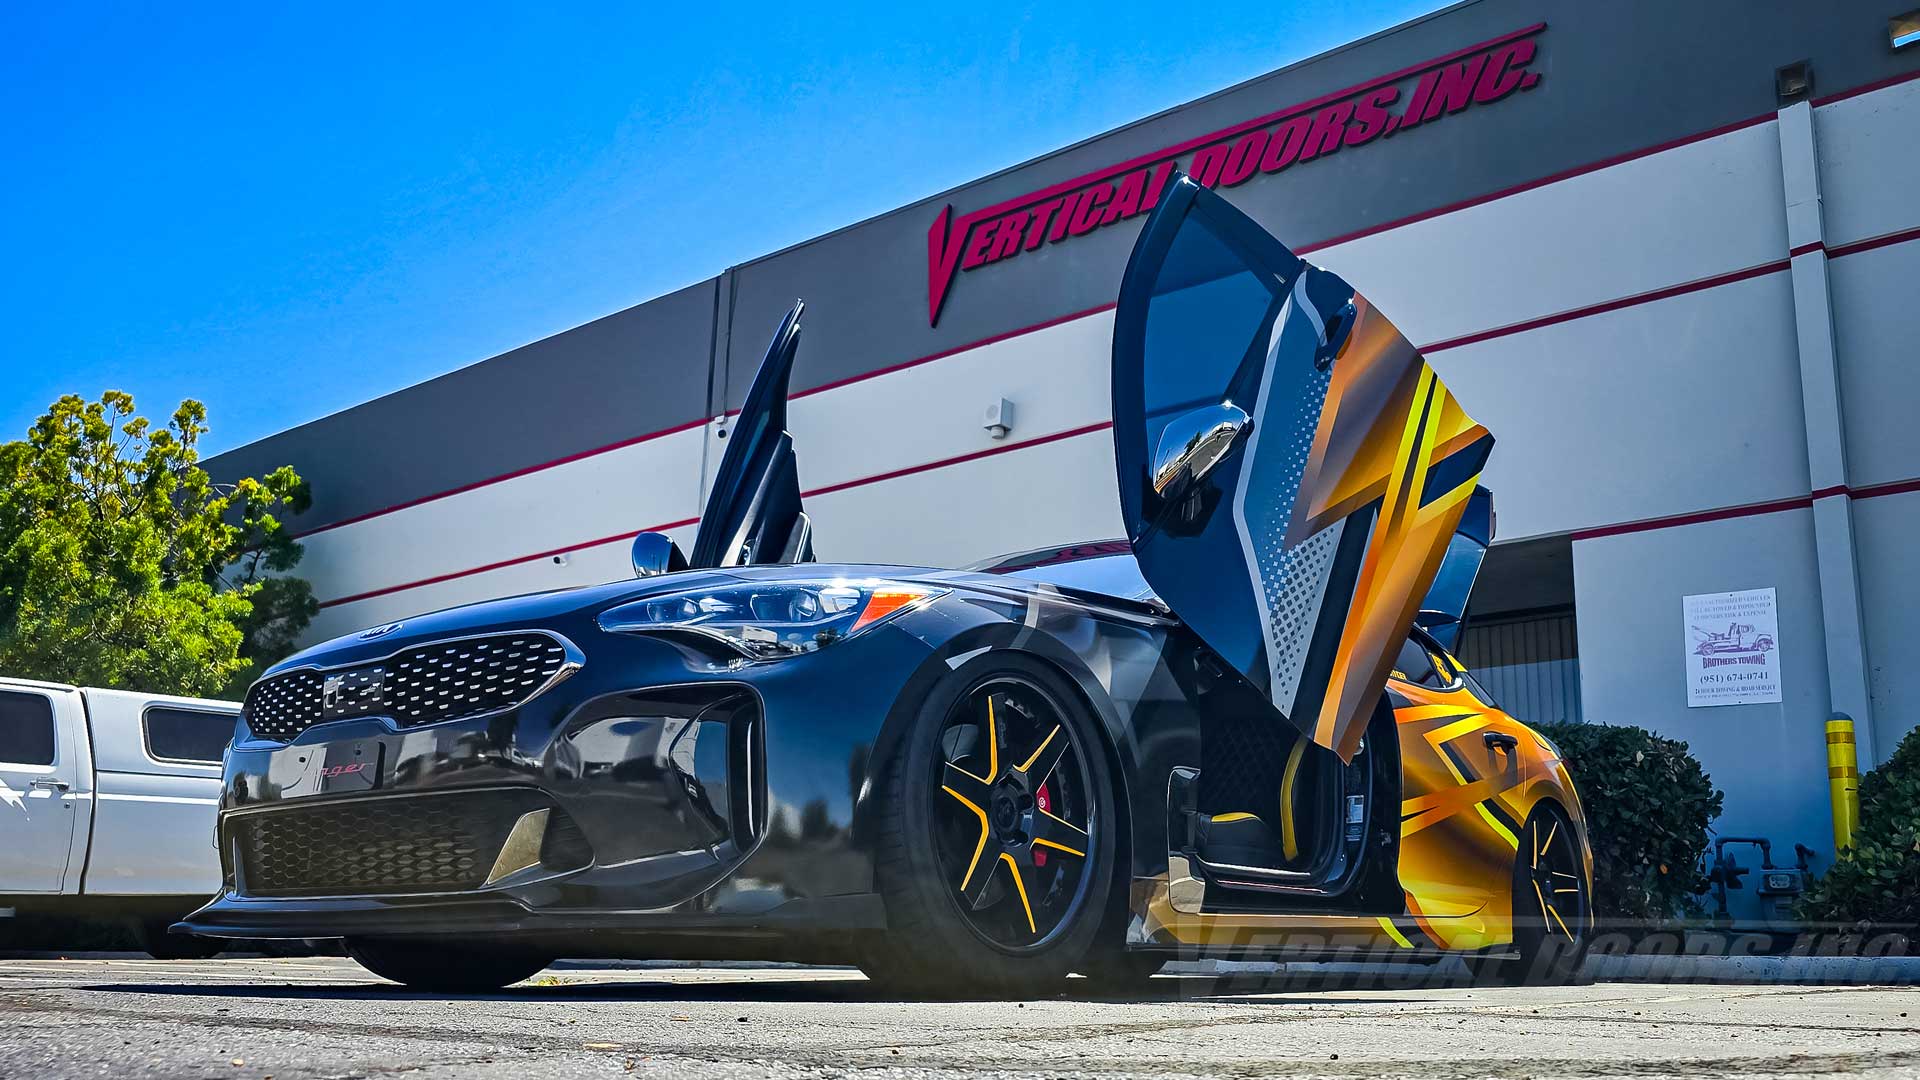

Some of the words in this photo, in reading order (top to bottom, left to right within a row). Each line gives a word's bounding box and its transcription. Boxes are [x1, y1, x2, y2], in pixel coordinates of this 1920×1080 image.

[1703, 657, 1737, 669] BROTHERS
[1738, 653, 1766, 665] TOWING
[1700, 674, 1724, 684] (951)
[1727, 671, 1768, 681] 674-0741
